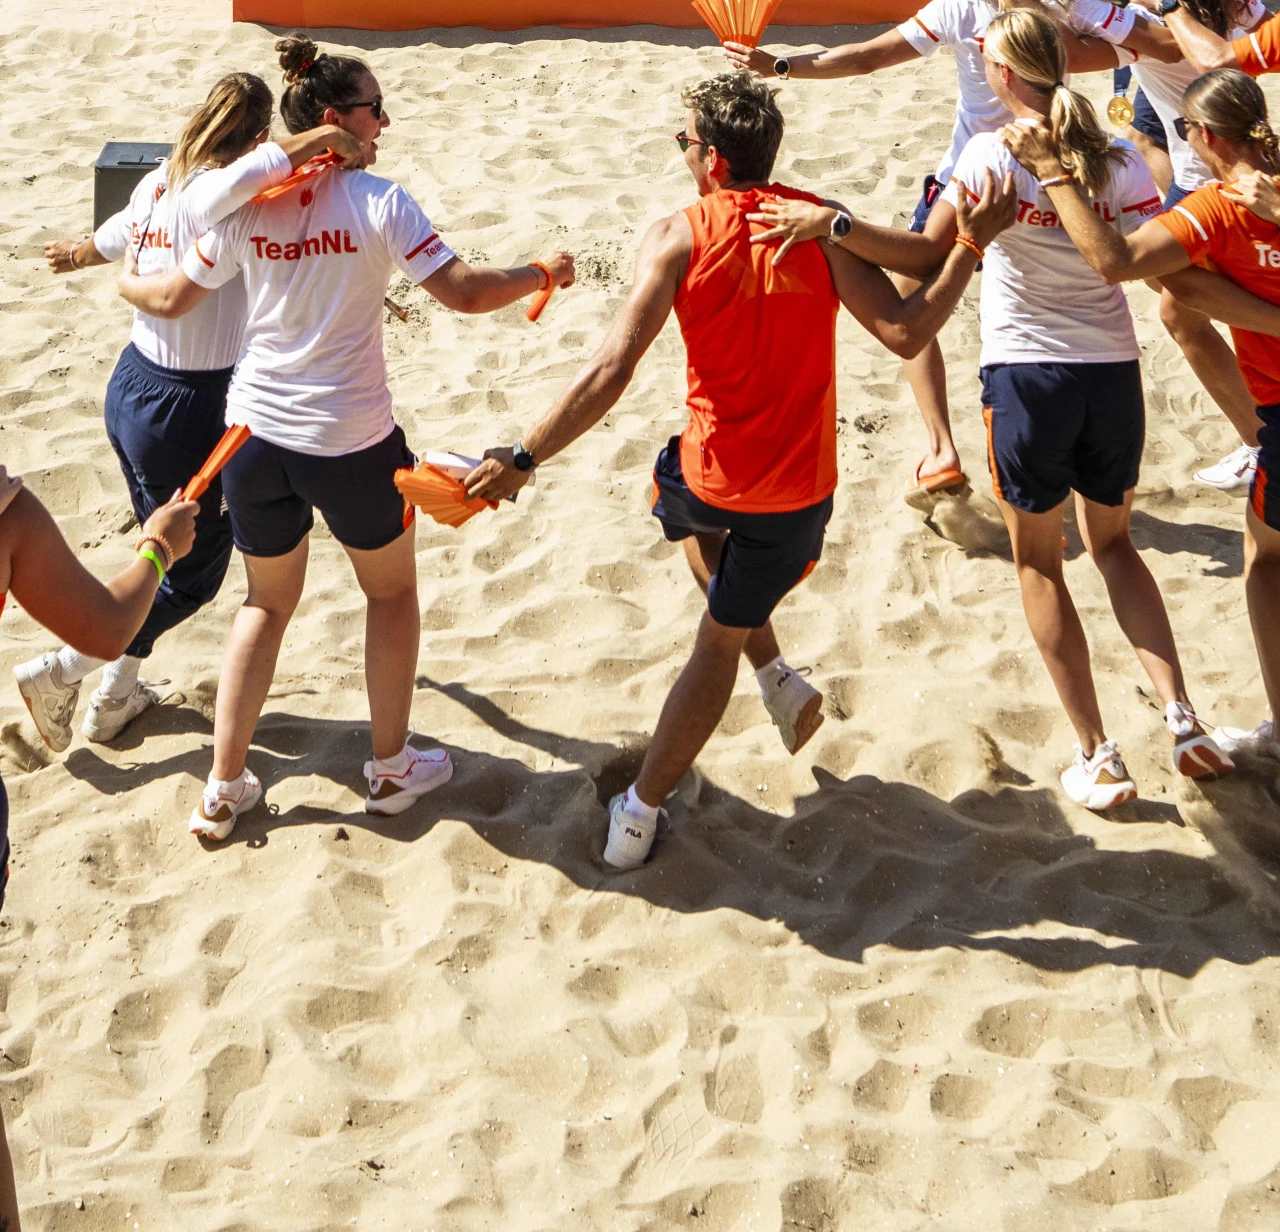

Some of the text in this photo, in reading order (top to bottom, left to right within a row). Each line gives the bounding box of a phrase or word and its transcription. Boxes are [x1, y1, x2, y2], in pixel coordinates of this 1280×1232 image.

[250, 229, 357, 261] TeamNL
[777, 671, 792, 688] FILA
[625, 826, 642, 839] FILA
